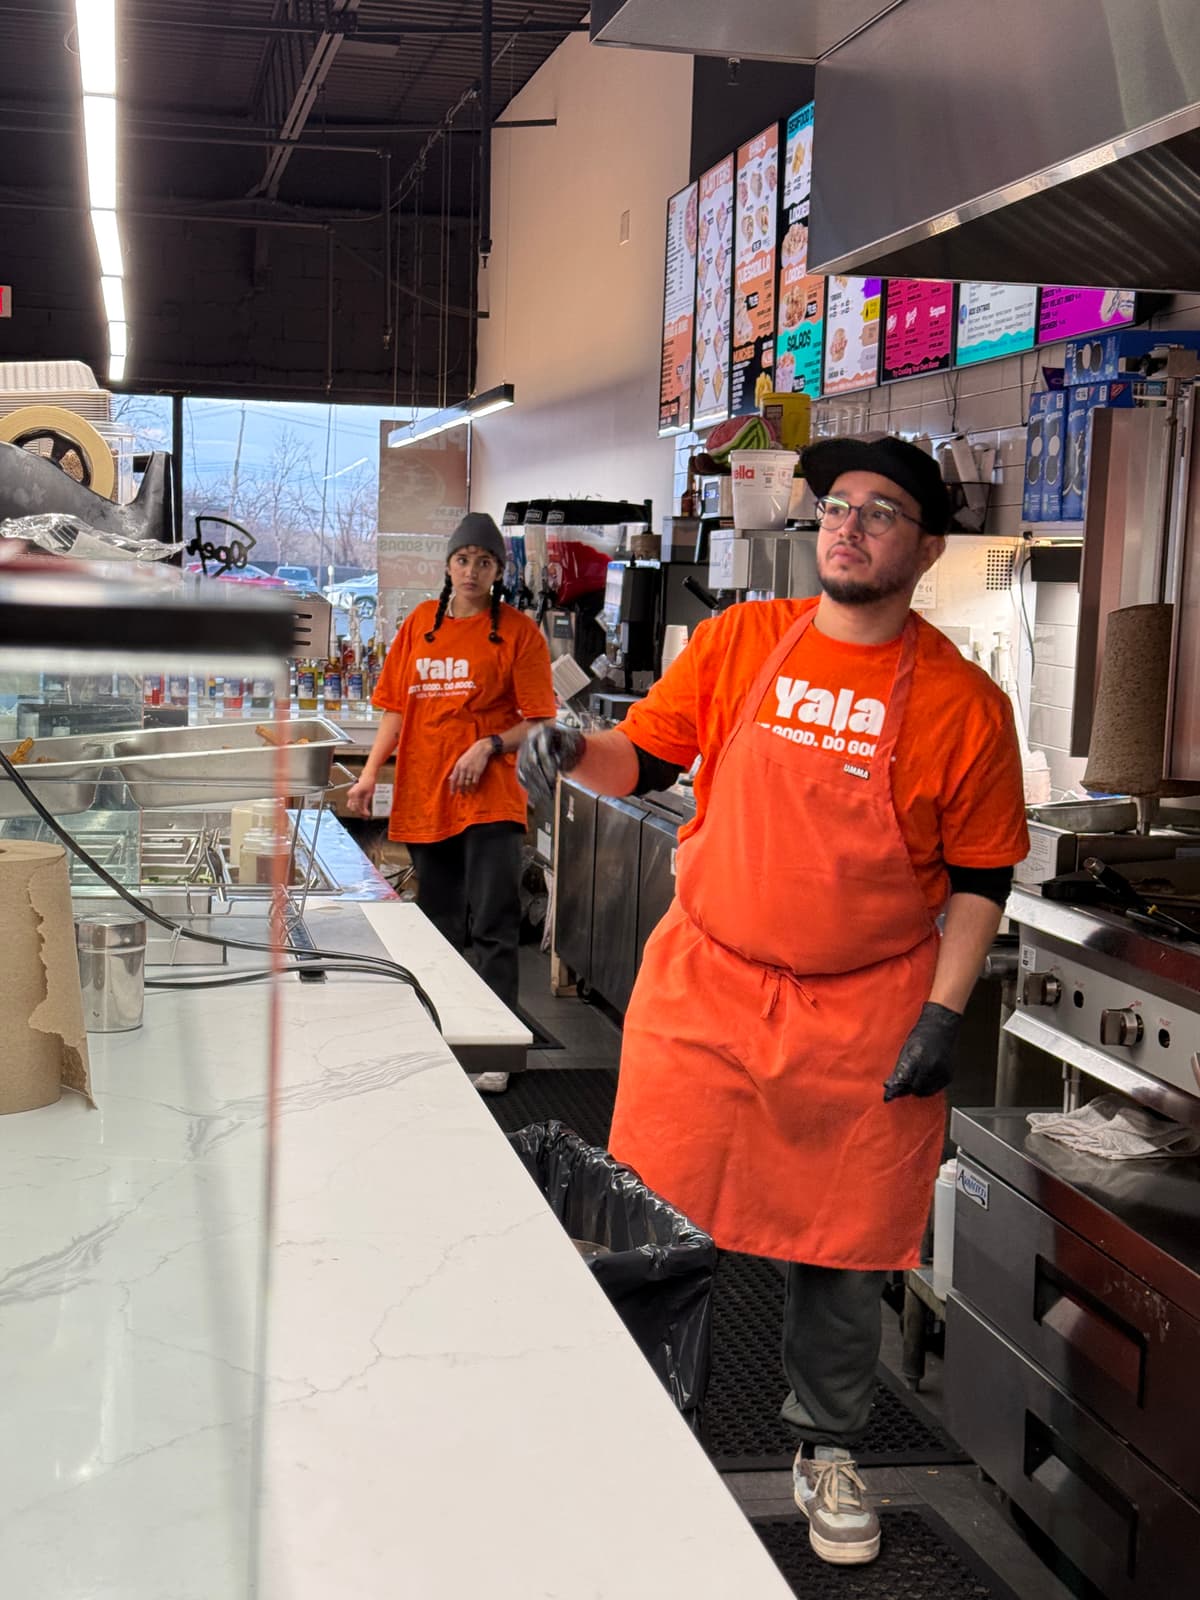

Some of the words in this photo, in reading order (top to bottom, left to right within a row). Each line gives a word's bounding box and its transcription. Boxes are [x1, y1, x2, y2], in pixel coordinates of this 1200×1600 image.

[416, 657, 469, 681] Yala
[776, 676, 886, 736] Yala
[772, 725, 819, 747] GOOD.
[821, 735, 845, 752] DO
[843, 763, 869, 779] UMMA
